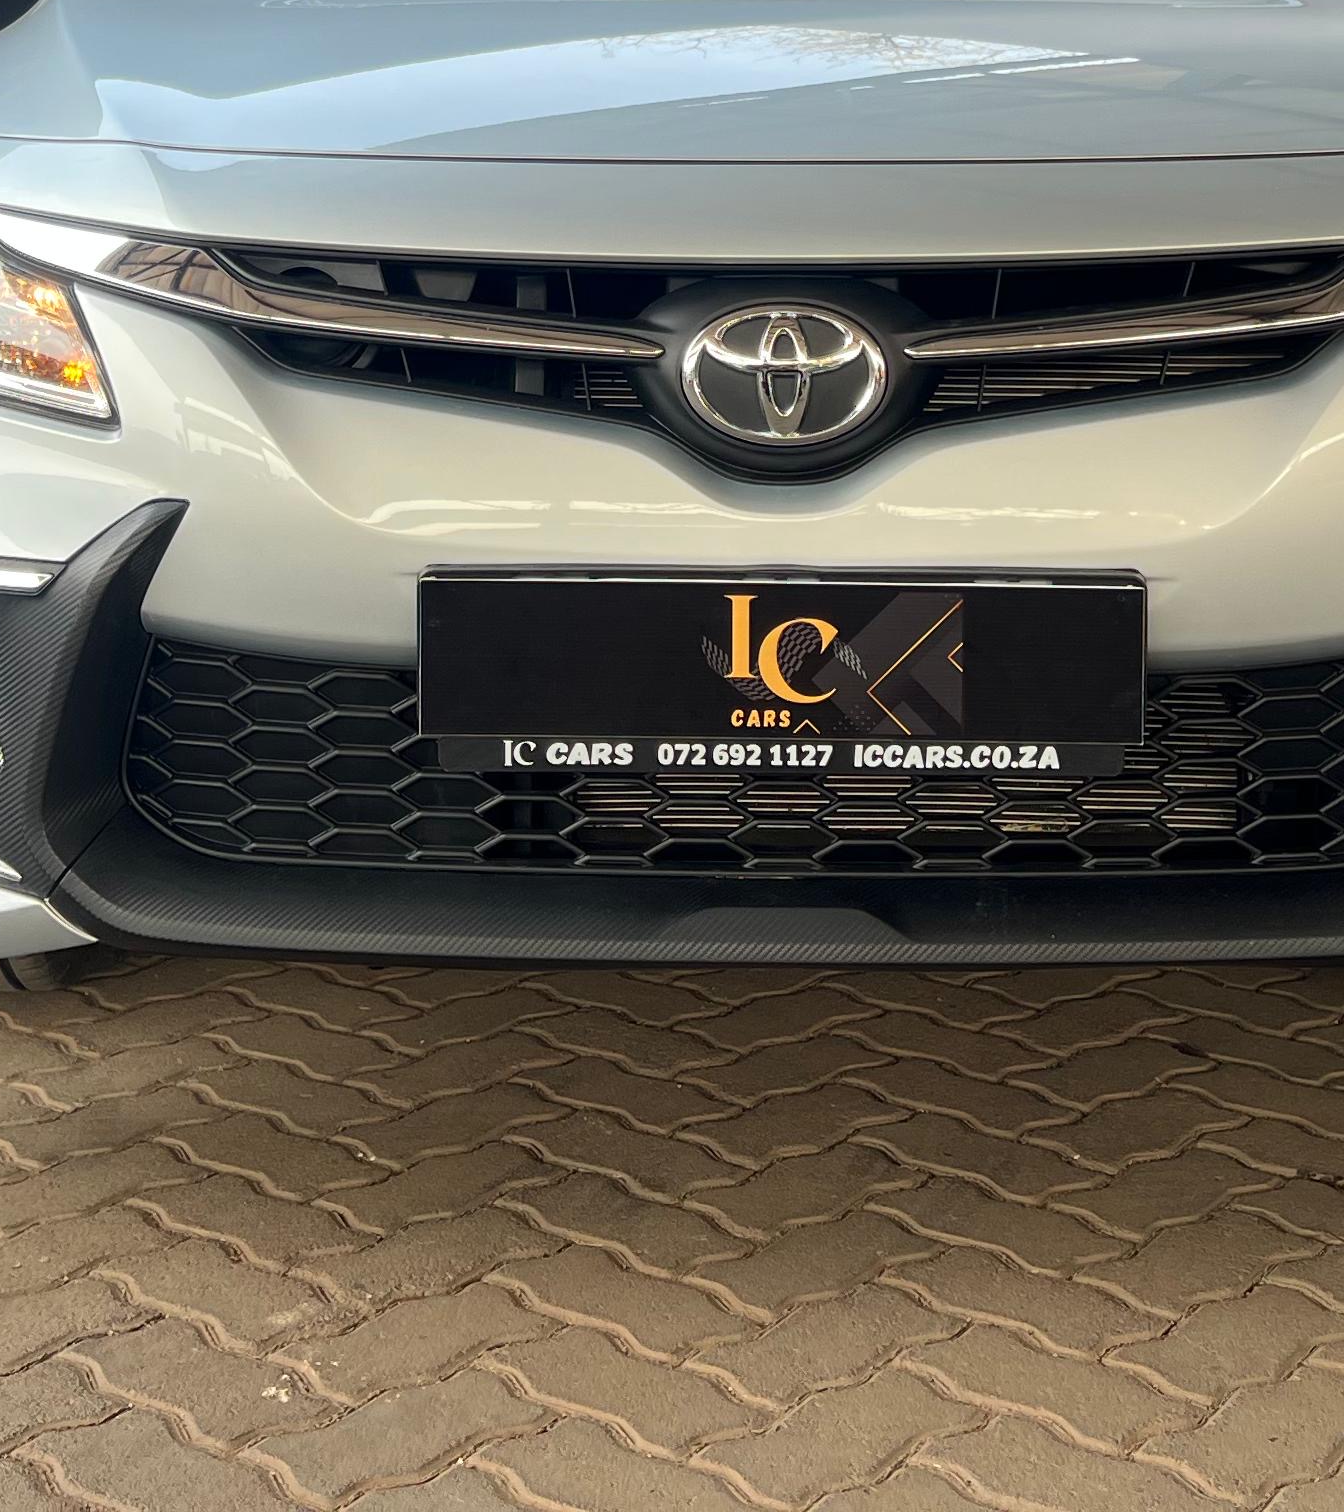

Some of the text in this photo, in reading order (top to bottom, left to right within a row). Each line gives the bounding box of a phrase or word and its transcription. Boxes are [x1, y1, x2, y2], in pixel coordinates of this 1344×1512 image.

[723, 594, 839, 704] IC
[730, 708, 792, 729] CARS
[502, 739, 1061, 770] IC CARS 072 692 1127 ICCARS.CO.ZA
